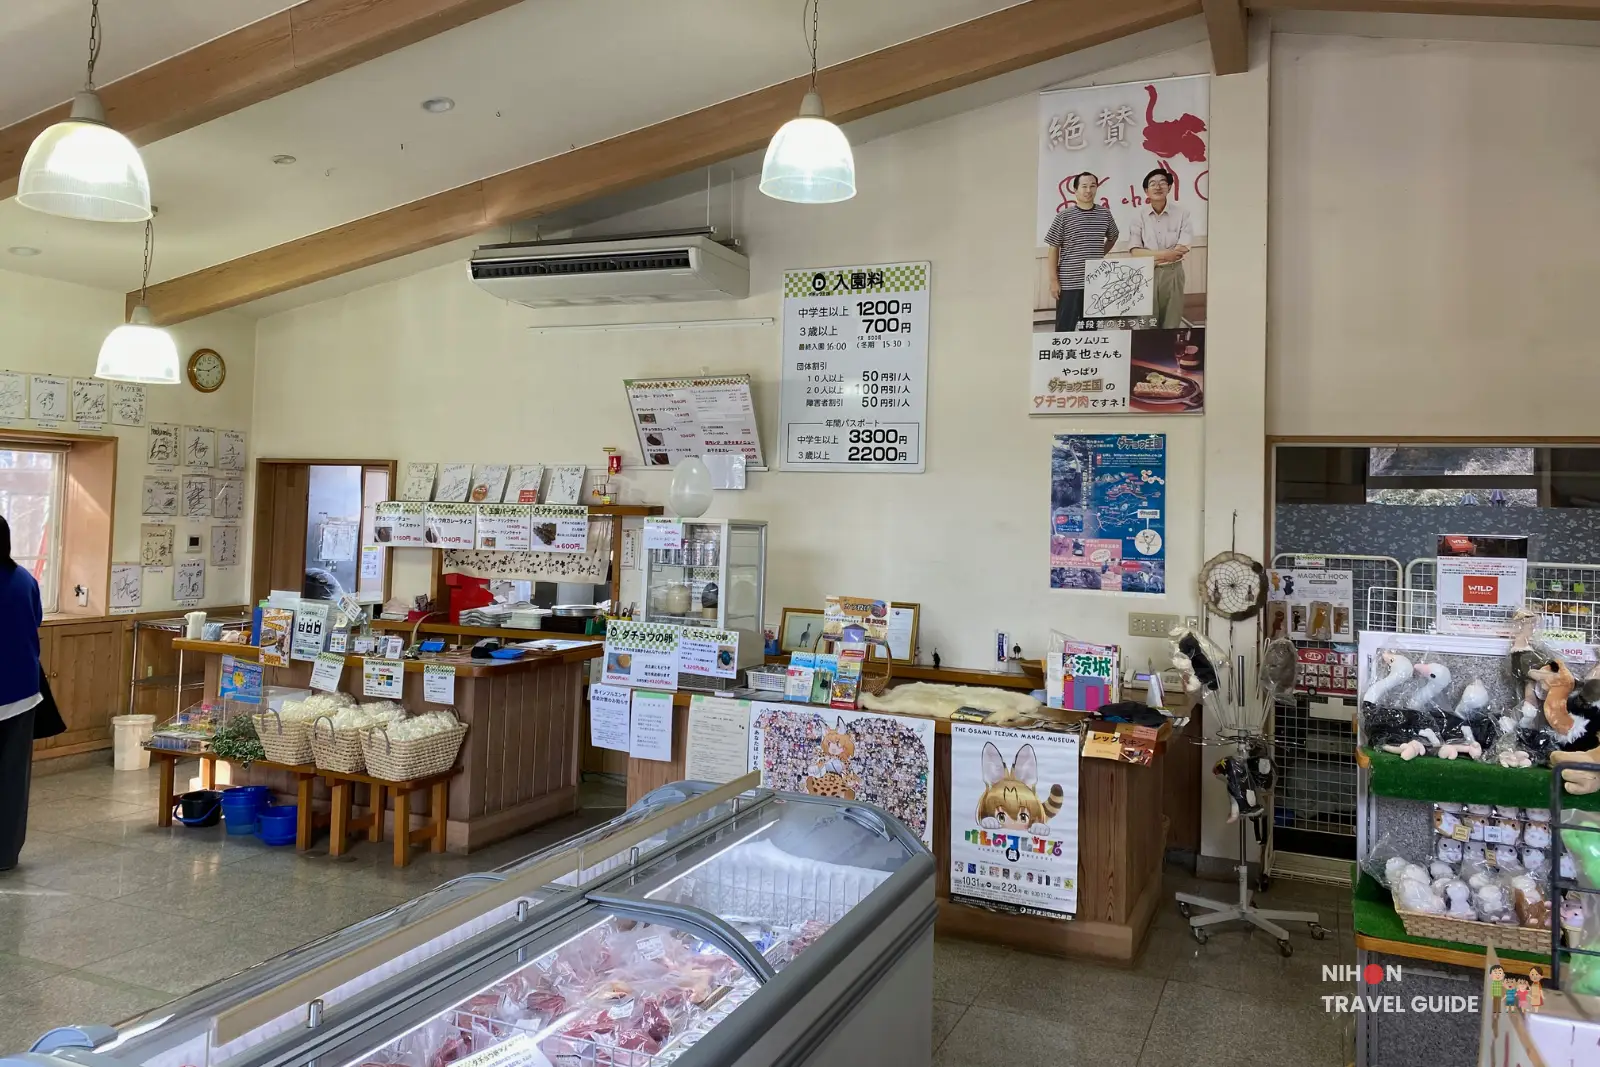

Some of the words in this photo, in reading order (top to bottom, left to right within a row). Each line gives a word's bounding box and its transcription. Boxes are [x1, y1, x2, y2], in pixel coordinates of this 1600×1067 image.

[1048, 105, 1137, 152] 絶賛
[833, 271, 884, 290] 入園料
[798, 307, 849, 318] 中学生以上
[856, 300, 912, 315] 1200円
[800, 326, 838, 336] 3歳以上
[862, 318, 911, 333] 700円
[827, 342, 847, 351] 16:00
[1052, 337, 1071, 345] あの
[1075, 337, 1109, 345] ソムリエ
[1039, 349, 1122, 360] 田崎真也さんも
[796, 362, 827, 371] 団体割引
[1062, 367, 1098, 376] やっぱり
[807, 374, 844, 383] 10人以上
[806, 386, 844, 394] 20人以上
[806, 399, 843, 407] 障害者割引
[825, 419, 880, 427] 年間パスポート
[797, 435, 838, 445] 中学生以上
[849, 430, 907, 444] 3300円
[1117, 436, 1164, 450] ダチョウ王国
[798, 451, 830, 460] 3歳以上
[848, 447, 907, 461] 2200円
[622, 629, 673, 643] ダチョウの卵
[693, 632, 728, 641] エミューの卵
[1075, 655, 1112, 676] 茨城
[592, 695, 629, 705] 感染対策のお知らせ
[1048, 736, 1076, 744] MUSEUM
[1093, 733, 1145, 747] レッグスキン
[964, 829, 1063, 856] けものフレンズ
